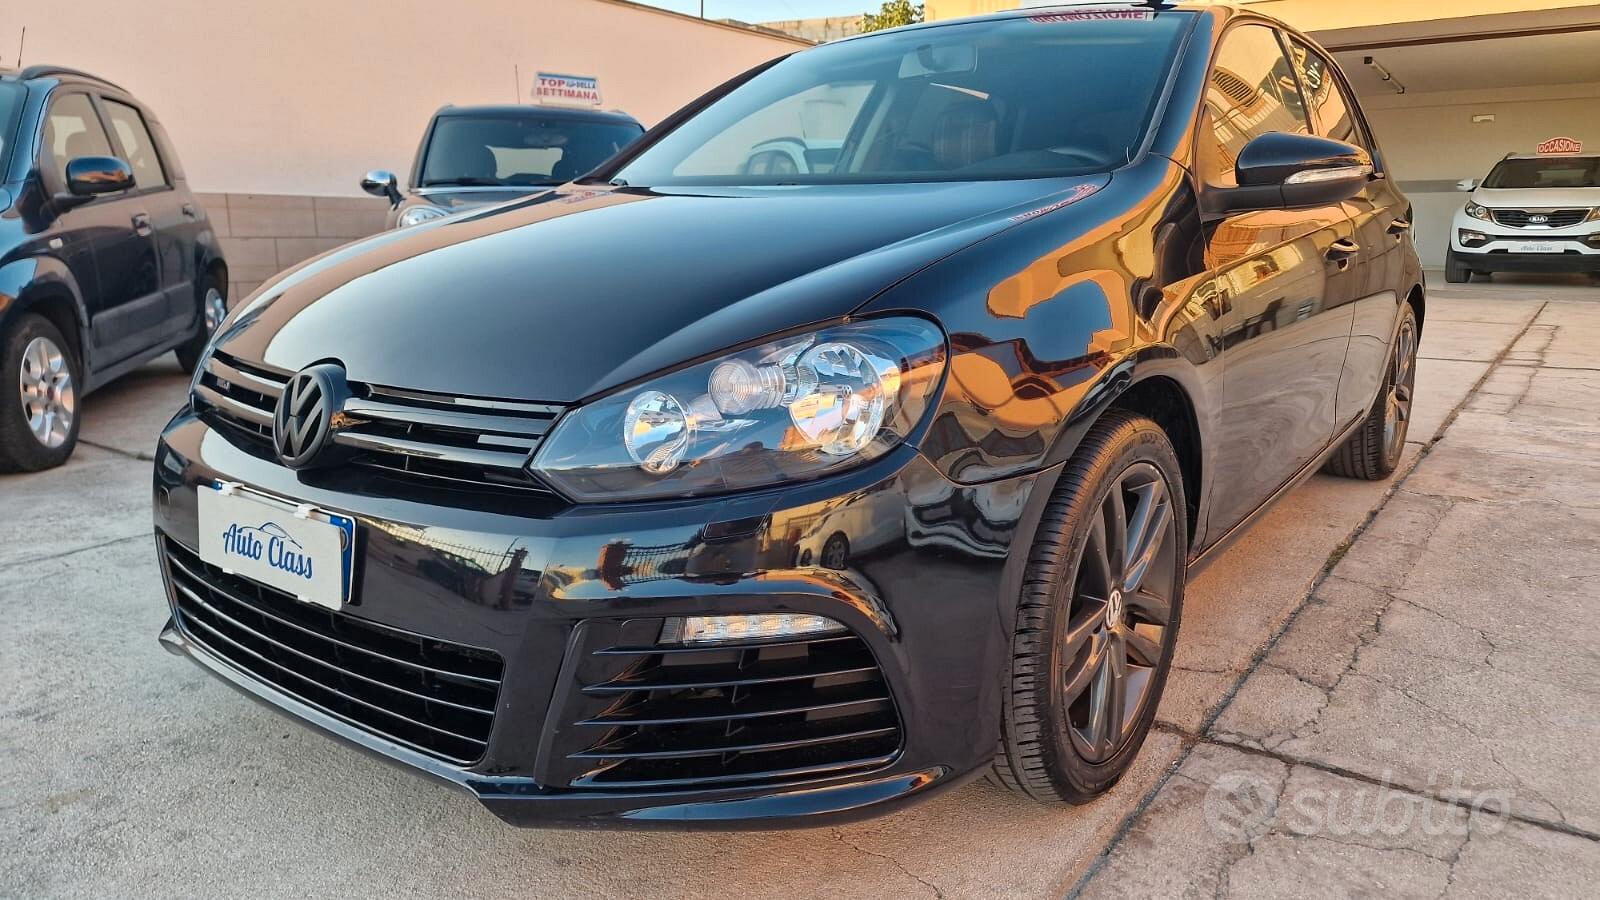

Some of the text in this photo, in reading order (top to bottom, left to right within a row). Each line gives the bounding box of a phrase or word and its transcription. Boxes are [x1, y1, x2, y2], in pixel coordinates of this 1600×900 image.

[540, 78, 565, 87] TOP
[536, 87, 598, 100] SETTIMANA
[1538, 139, 1581, 153] OCCASIONE
[1531, 215, 1546, 223] KIA
[223, 523, 313, 579] Auto Class
